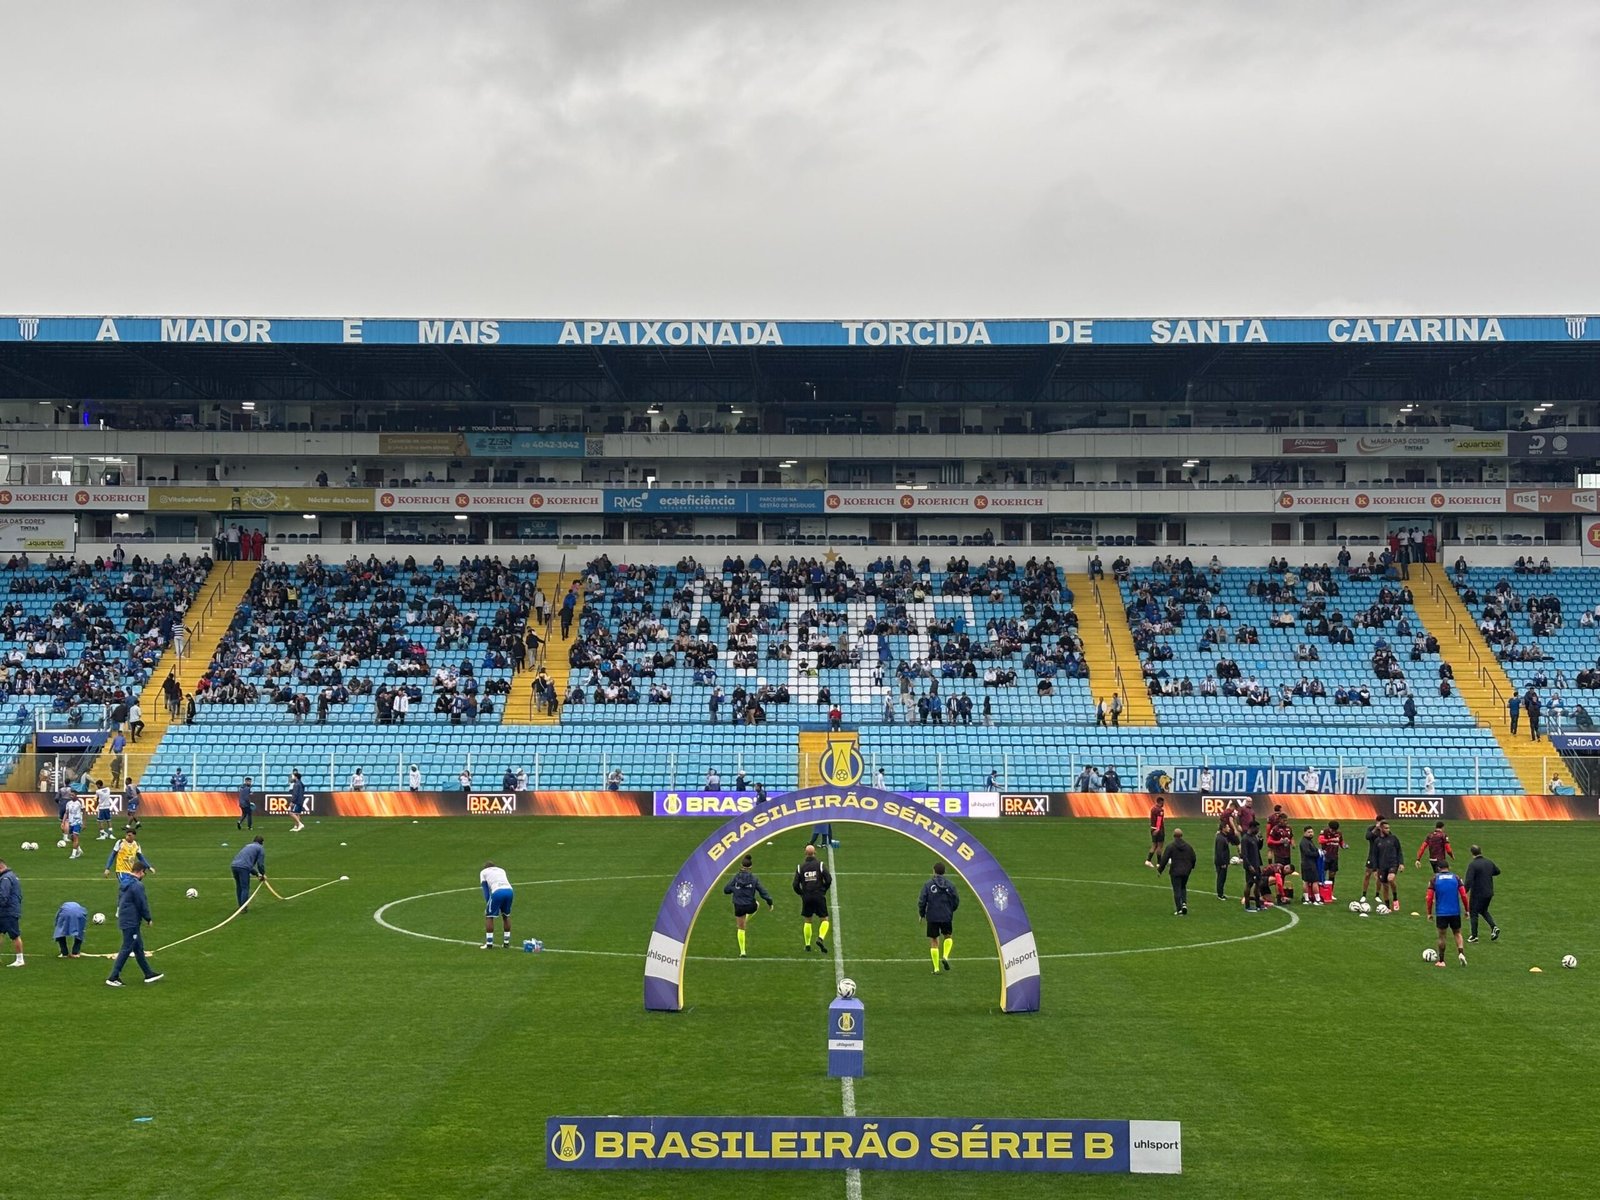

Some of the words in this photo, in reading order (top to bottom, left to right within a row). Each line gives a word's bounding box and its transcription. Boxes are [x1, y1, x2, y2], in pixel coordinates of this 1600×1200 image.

[95, 318, 120, 341] A
[160, 319, 272, 343] MAIOR
[342, 320, 363, 343] E
[418, 320, 500, 344] MAIS
[557, 321, 784, 346] APAIXONADA
[841, 321, 992, 346] TORCIDA
[1049, 320, 1094, 344] DE
[1151, 319, 1269, 343] SANTA
[1327, 318, 1505, 342] CATARINA
[532, 441, 580, 449] 4042-3042
[15, 493, 68, 502] KOERICH
[92, 494, 146, 503] KOERICH
[397, 496, 450, 504] KOERICH
[472, 496, 525, 505] KOERICH
[546, 497, 599, 505] KOERICH
[614, 496, 643, 508] RMS
[843, 497, 895, 506] KOERICH
[917, 497, 969, 506] KOERICH
[991, 498, 1043, 506] KOERICH
[1297, 497, 1350, 505] KOERICH
[1372, 496, 1426, 505] KOERICH
[1448, 497, 1501, 505] KOERICH
[1516, 495, 1537, 503] nsc
[1540, 495, 1553, 503] TV
[1574, 495, 1595, 503] nsc
[52, 735, 79, 744] SAÍDA
[80, 735, 92, 744] 04
[1567, 736, 1593, 747] SAÍDA
[1252, 769, 1334, 794] AUTISA
[78, 797, 120, 812] RX
[269, 797, 310, 811] BRX
[470, 796, 513, 811] BRAX
[944, 797, 962, 813] B
[970, 801, 996, 809] uhlsport
[1005, 798, 1045, 812] BRAX
[1398, 800, 1439, 814] BRAX
[707, 792, 879, 862] BRASILEIRÃO
[882, 801, 958, 847] SÉRIE
[956, 842, 976, 861] B
[804, 870, 817, 878] CBF
[1004, 949, 1037, 970] uhlsport
[594, 1123, 920, 1160] BRASILEIRÃO
[929, 1124, 1073, 1160] SÉRIE
[1084, 1132, 1114, 1160] B
[1133, 1139, 1180, 1152] uhlsport
